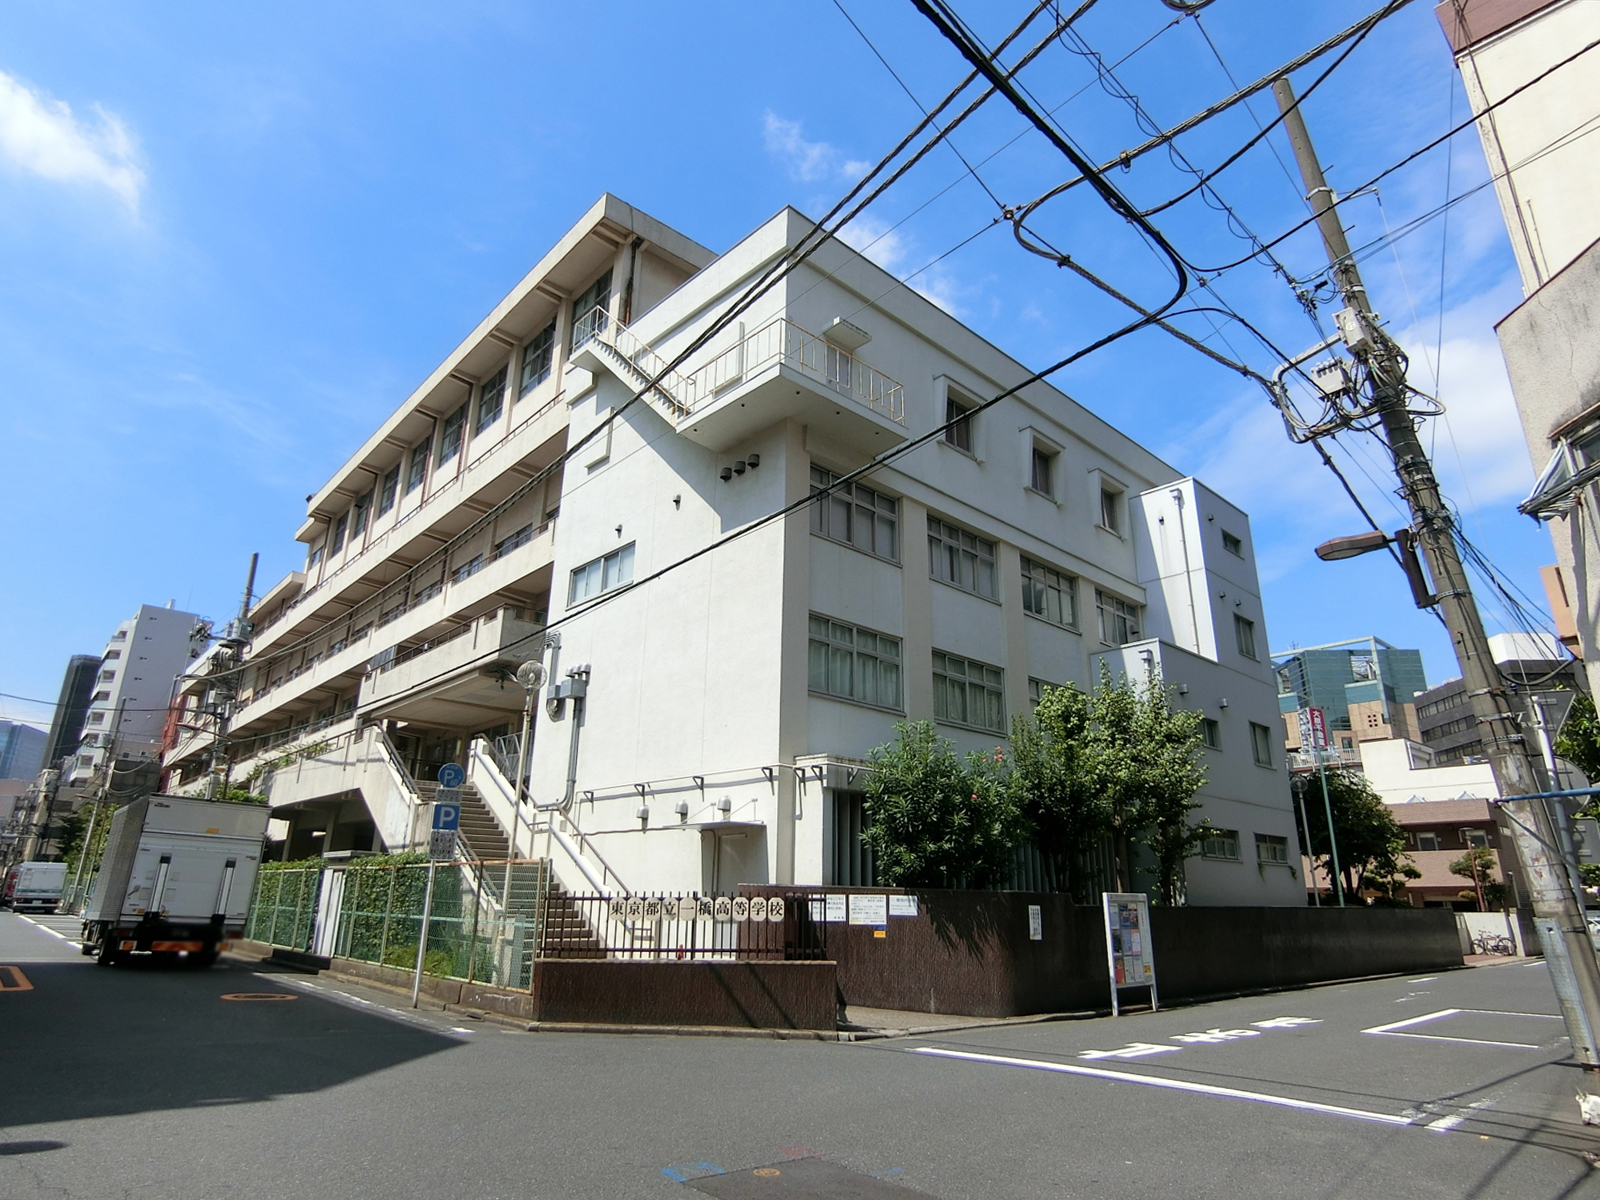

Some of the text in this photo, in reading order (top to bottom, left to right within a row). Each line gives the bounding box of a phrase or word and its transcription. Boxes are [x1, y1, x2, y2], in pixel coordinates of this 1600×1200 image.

[444, 769, 455, 785] P
[439, 806, 456, 828] P
[610, 901, 783, 916] 東京都立一橋高等学校
